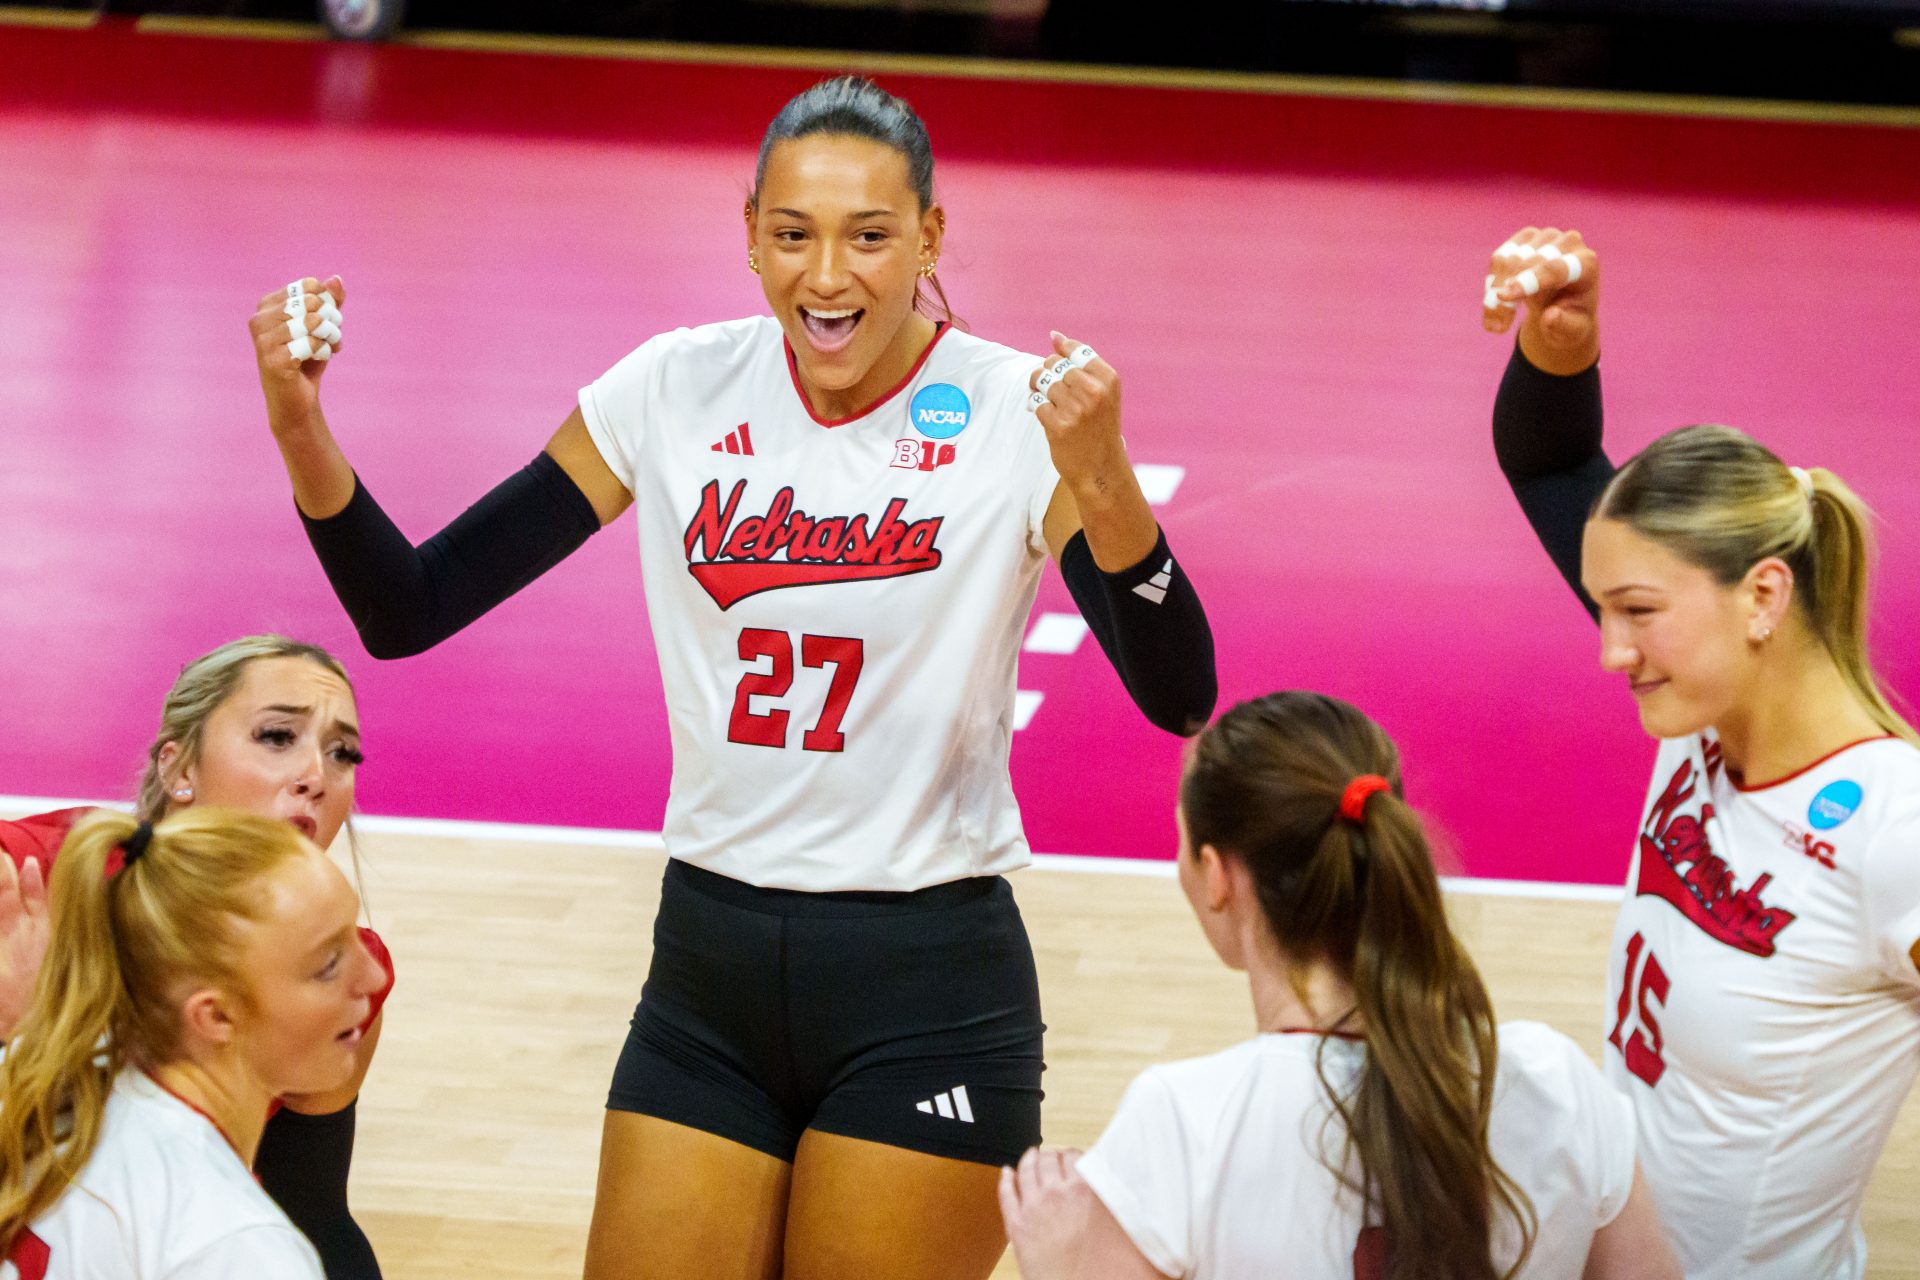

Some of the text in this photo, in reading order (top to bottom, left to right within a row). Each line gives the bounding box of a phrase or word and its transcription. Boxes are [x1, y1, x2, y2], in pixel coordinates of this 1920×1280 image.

[917, 408, 967, 426] NCAA
[684, 478, 945, 568] Nebraska
[727, 627, 864, 753] 27
[1608, 930, 1672, 1089] 15
